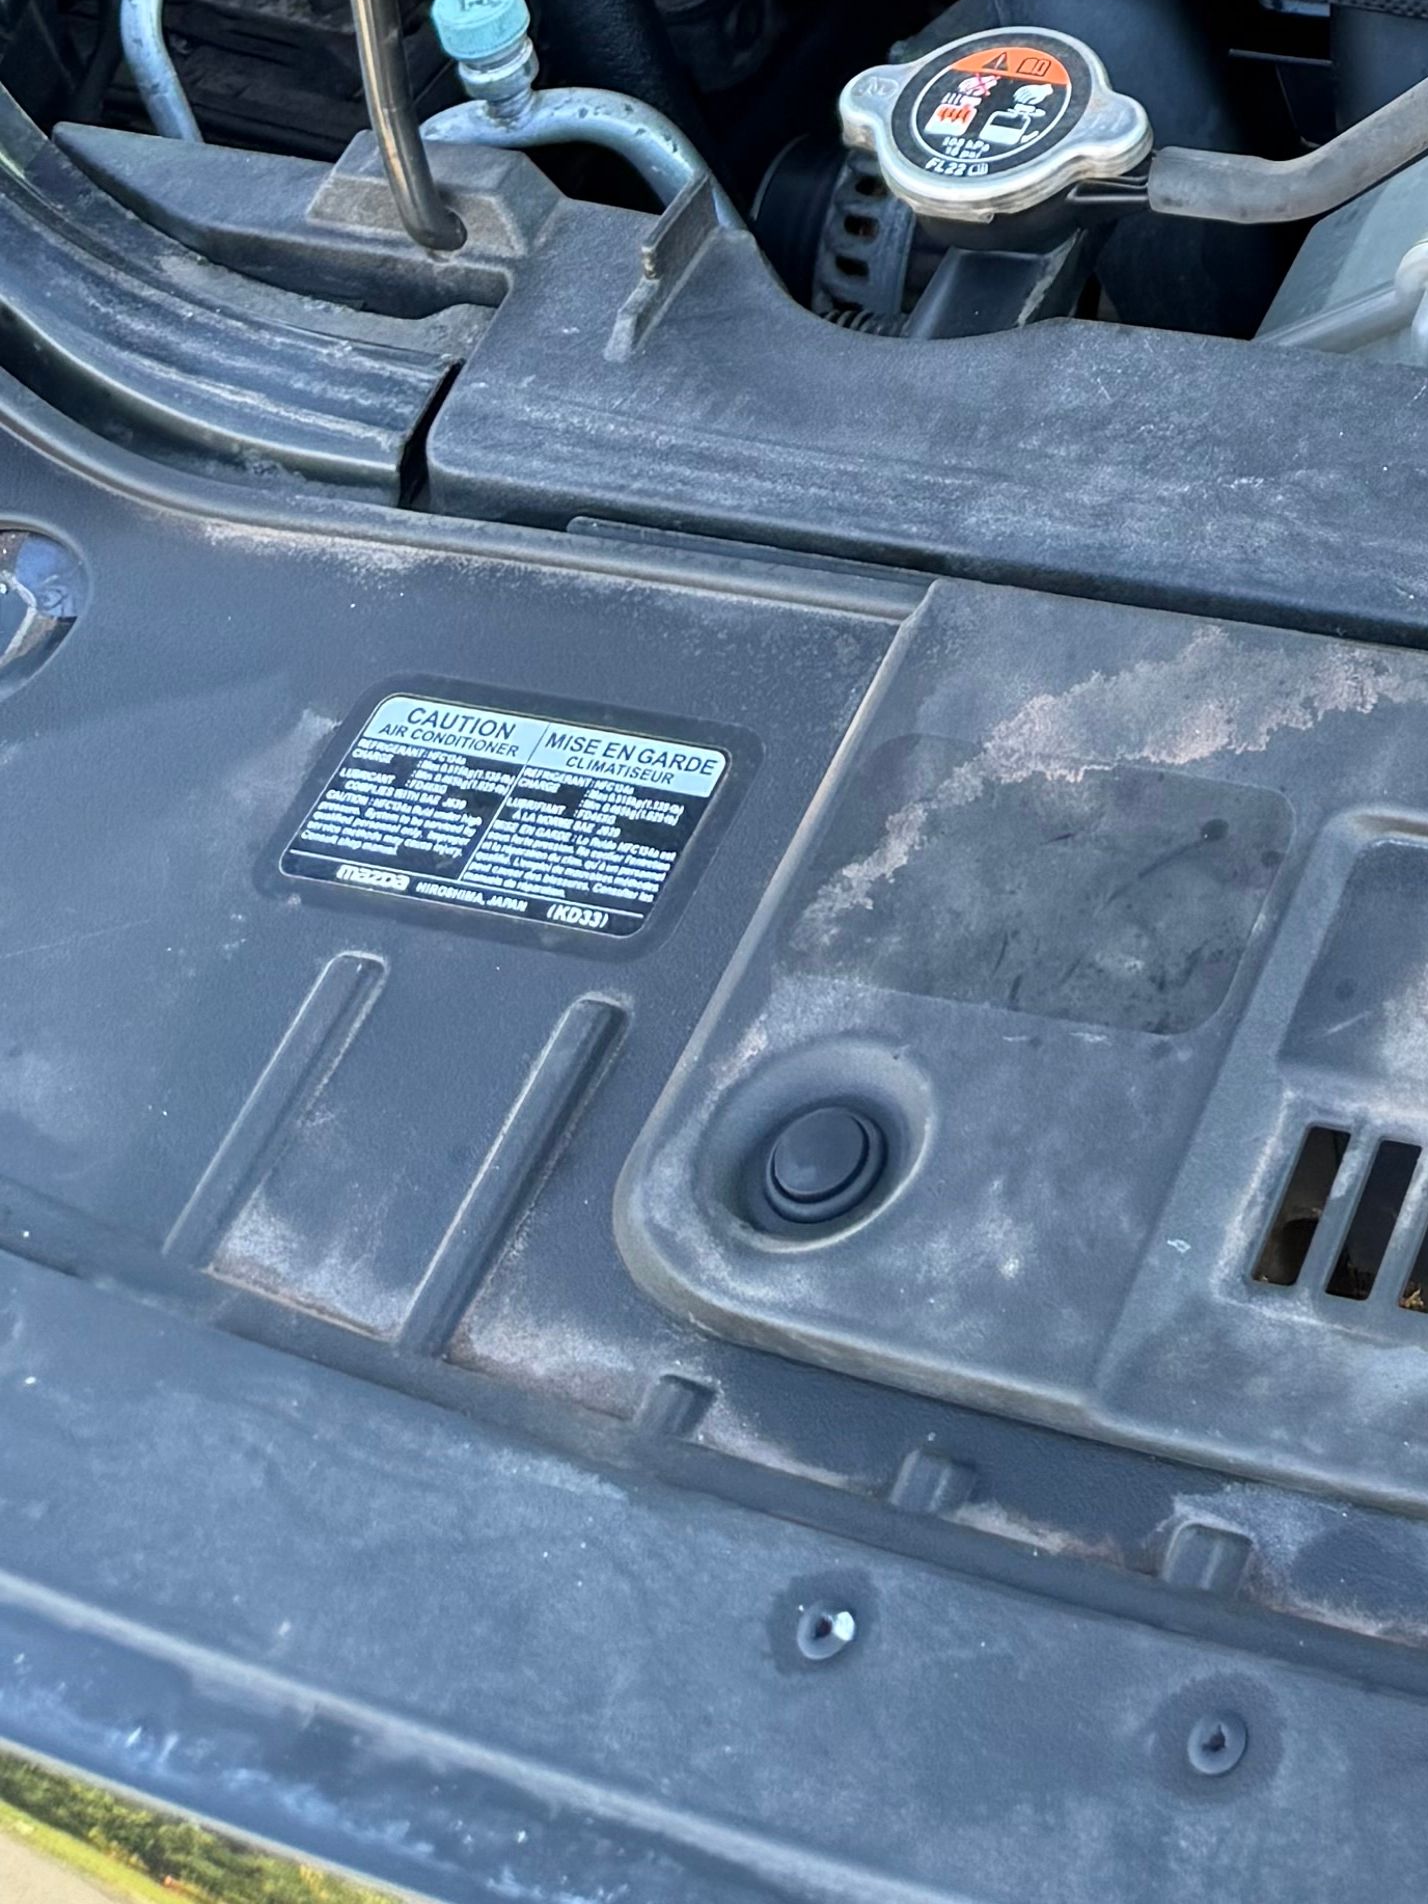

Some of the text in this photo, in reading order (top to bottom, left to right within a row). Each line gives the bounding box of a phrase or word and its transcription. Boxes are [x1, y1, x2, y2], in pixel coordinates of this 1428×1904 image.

[926, 157, 967, 176] FL22
[406, 707, 516, 738] CAUTION
[379, 724, 518, 756] AIR CONDITIONER
[546, 733, 716, 774] MISE EN GARDE
[566, 756, 673, 783] CLIMATISEUR
[336, 864, 410, 890] mazda
[487, 894, 528, 911] JAPAN
[546, 904, 608, 928] (KD33)
